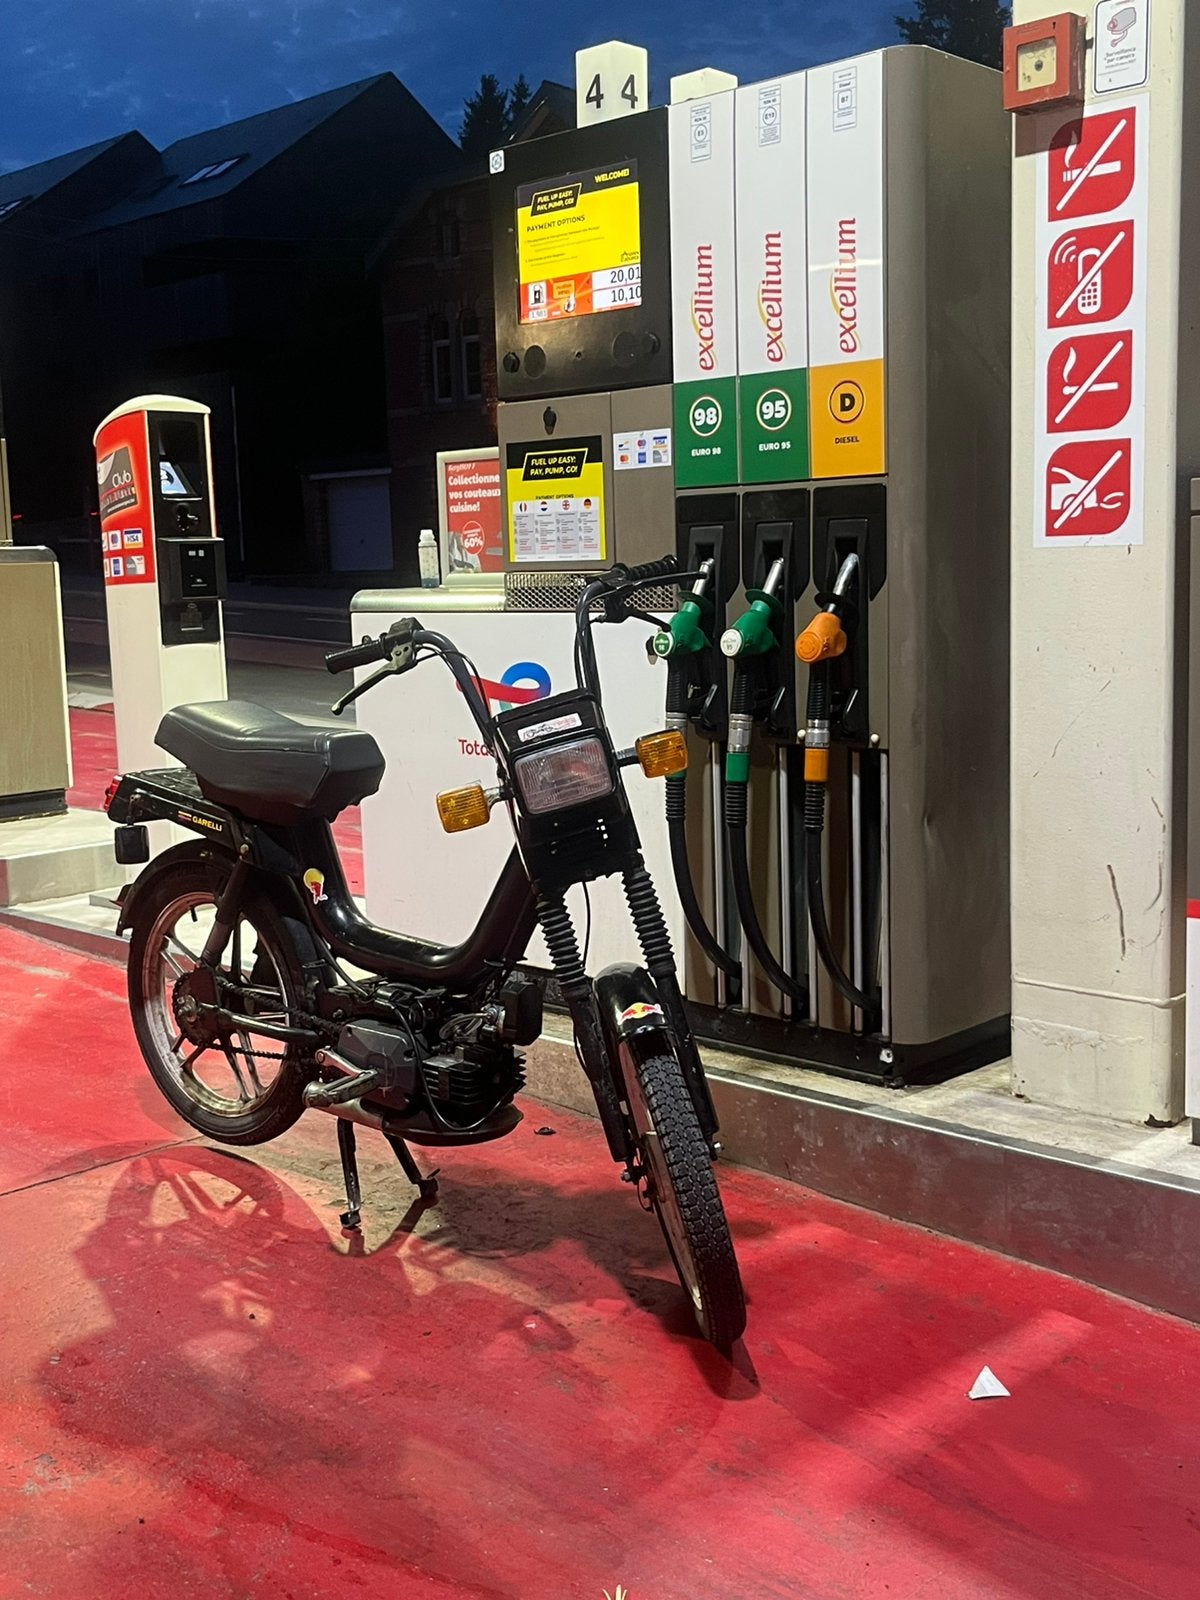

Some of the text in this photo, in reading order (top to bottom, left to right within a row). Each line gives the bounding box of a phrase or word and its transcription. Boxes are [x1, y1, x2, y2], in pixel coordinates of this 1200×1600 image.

[586, 73, 604, 109] 4
[621, 74, 638, 109] 4
[526, 214, 585, 233] PAYMENT OPTIONS
[610, 266, 641, 285] 20,01
[611, 285, 641, 303] 10,10
[834, 217, 857, 353] excellium
[761, 231, 783, 362] excellium
[694, 244, 714, 370] excellium
[761, 399, 786, 420] 95
[839, 393, 856, 412] D
[693, 407, 718, 426] 98
[758, 441, 791, 451] EURO 95
[834, 436, 860, 444] DIESEL
[691, 447, 721, 457] EURO 98
[531, 458, 547, 466] FUEL
[548, 457, 557, 465] UP
[112, 470, 132, 488] Club
[448, 491, 463, 499] vos
[449, 501, 480, 513] cuisine!
[127, 534, 139, 543] VISA
[464, 536, 483, 548] 60%
[192, 815, 222, 832] GARELLI
